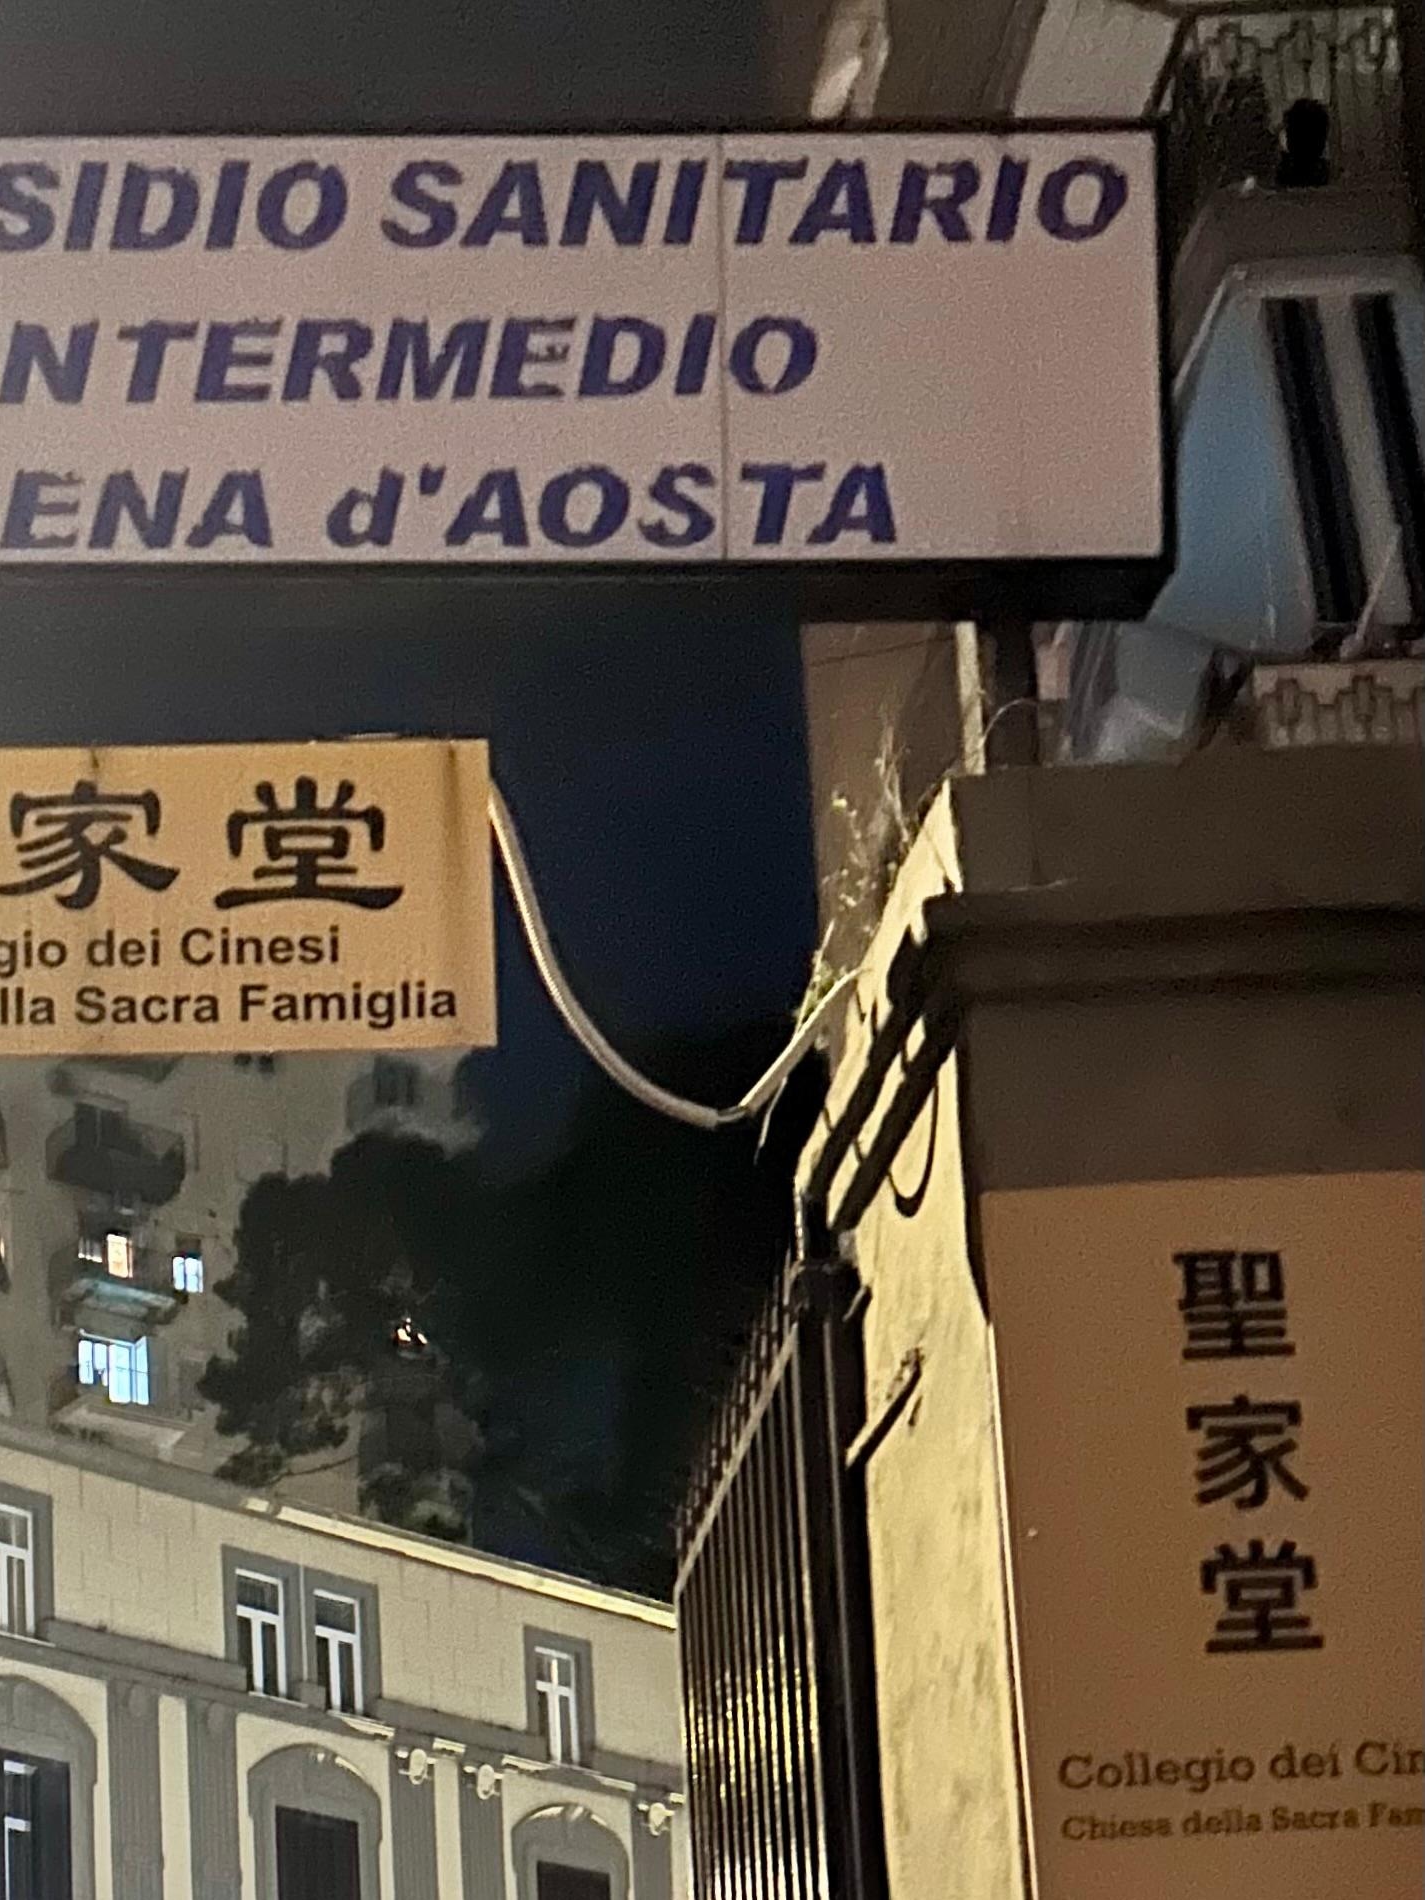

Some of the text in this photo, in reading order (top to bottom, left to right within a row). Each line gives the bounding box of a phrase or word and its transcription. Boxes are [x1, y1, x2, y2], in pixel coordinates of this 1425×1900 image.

[380, 155, 1129, 248] SANITARIO
[325, 461, 899, 550] d'AOSTA
[85, 924, 160, 968] dei
[180, 923, 341, 966] Cinesi
[74, 984, 220, 1025] Sacra
[239, 979, 458, 1030] Famiglia
[1172, 1247, 1326, 1656] 聖家堂
[1058, 1747, 1257, 1794] Collegio
[1268, 1742, 1344, 1780] dei
[1060, 1812, 1175, 1841] Chiesa
[1180, 1807, 1264, 1837] della
[1271, 1804, 1359, 1833] Sacra
